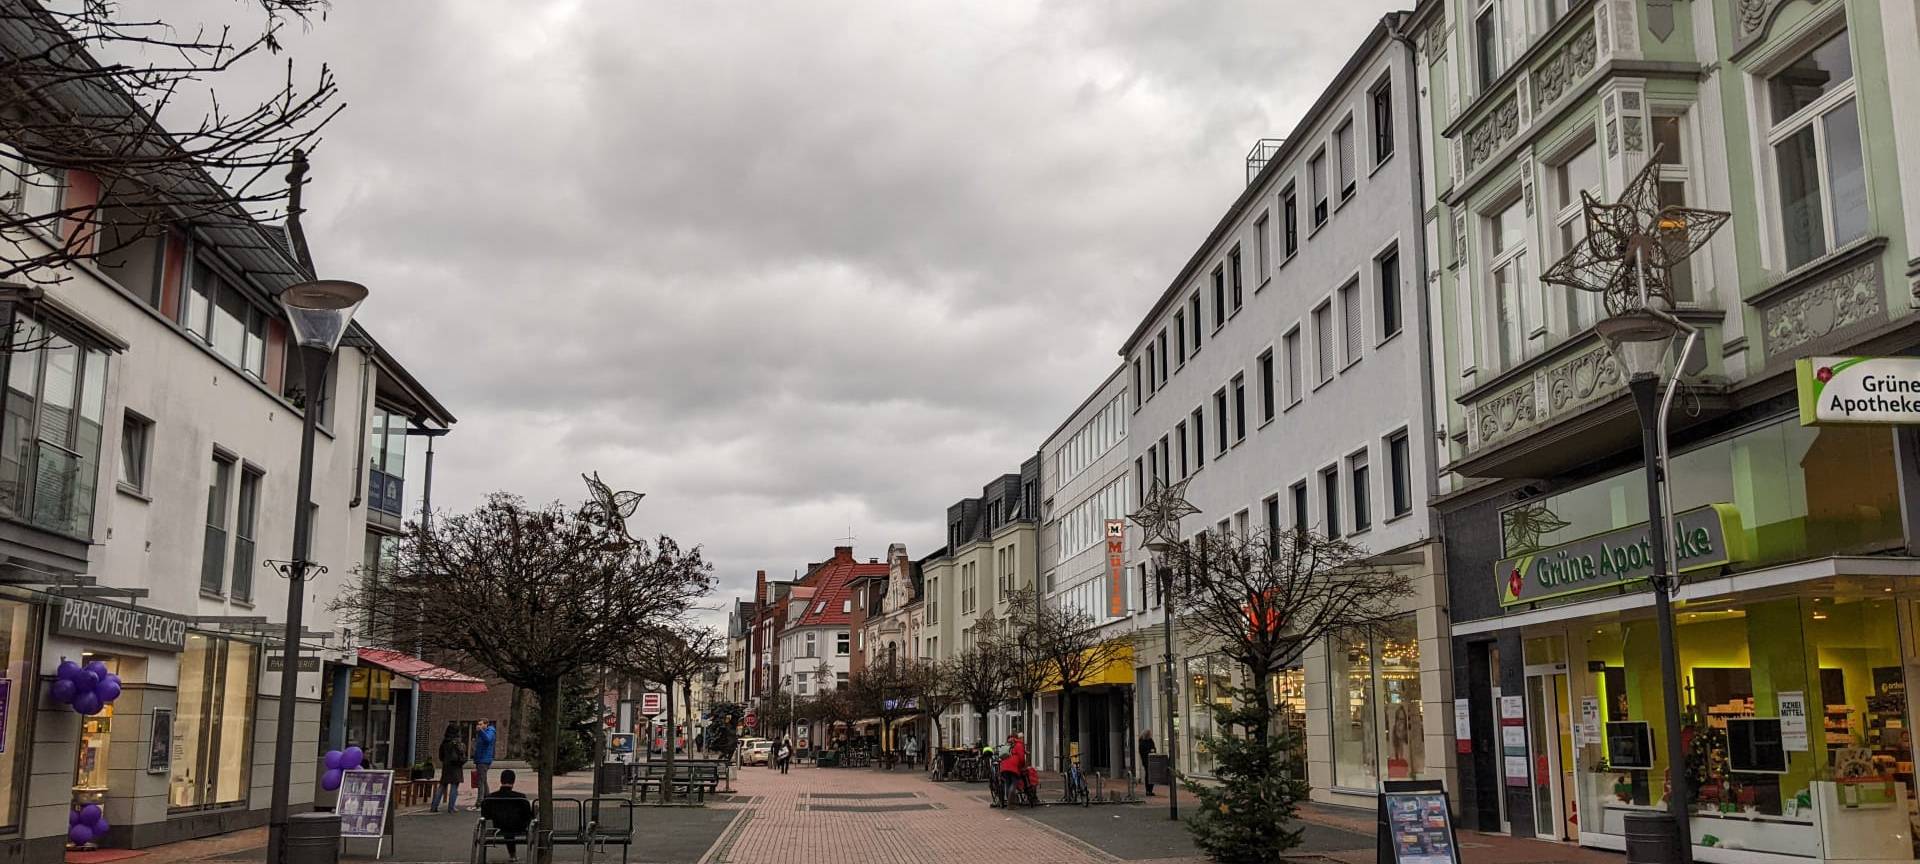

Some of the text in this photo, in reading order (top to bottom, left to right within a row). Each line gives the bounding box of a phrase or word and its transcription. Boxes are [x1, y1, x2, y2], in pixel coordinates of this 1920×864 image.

[1862, 375, 1920, 392] Grüne
[1830, 394, 1920, 416] Apotheke
[1536, 520, 1712, 588] Grüne Apotke
[144, 613, 186, 646] BECKER
